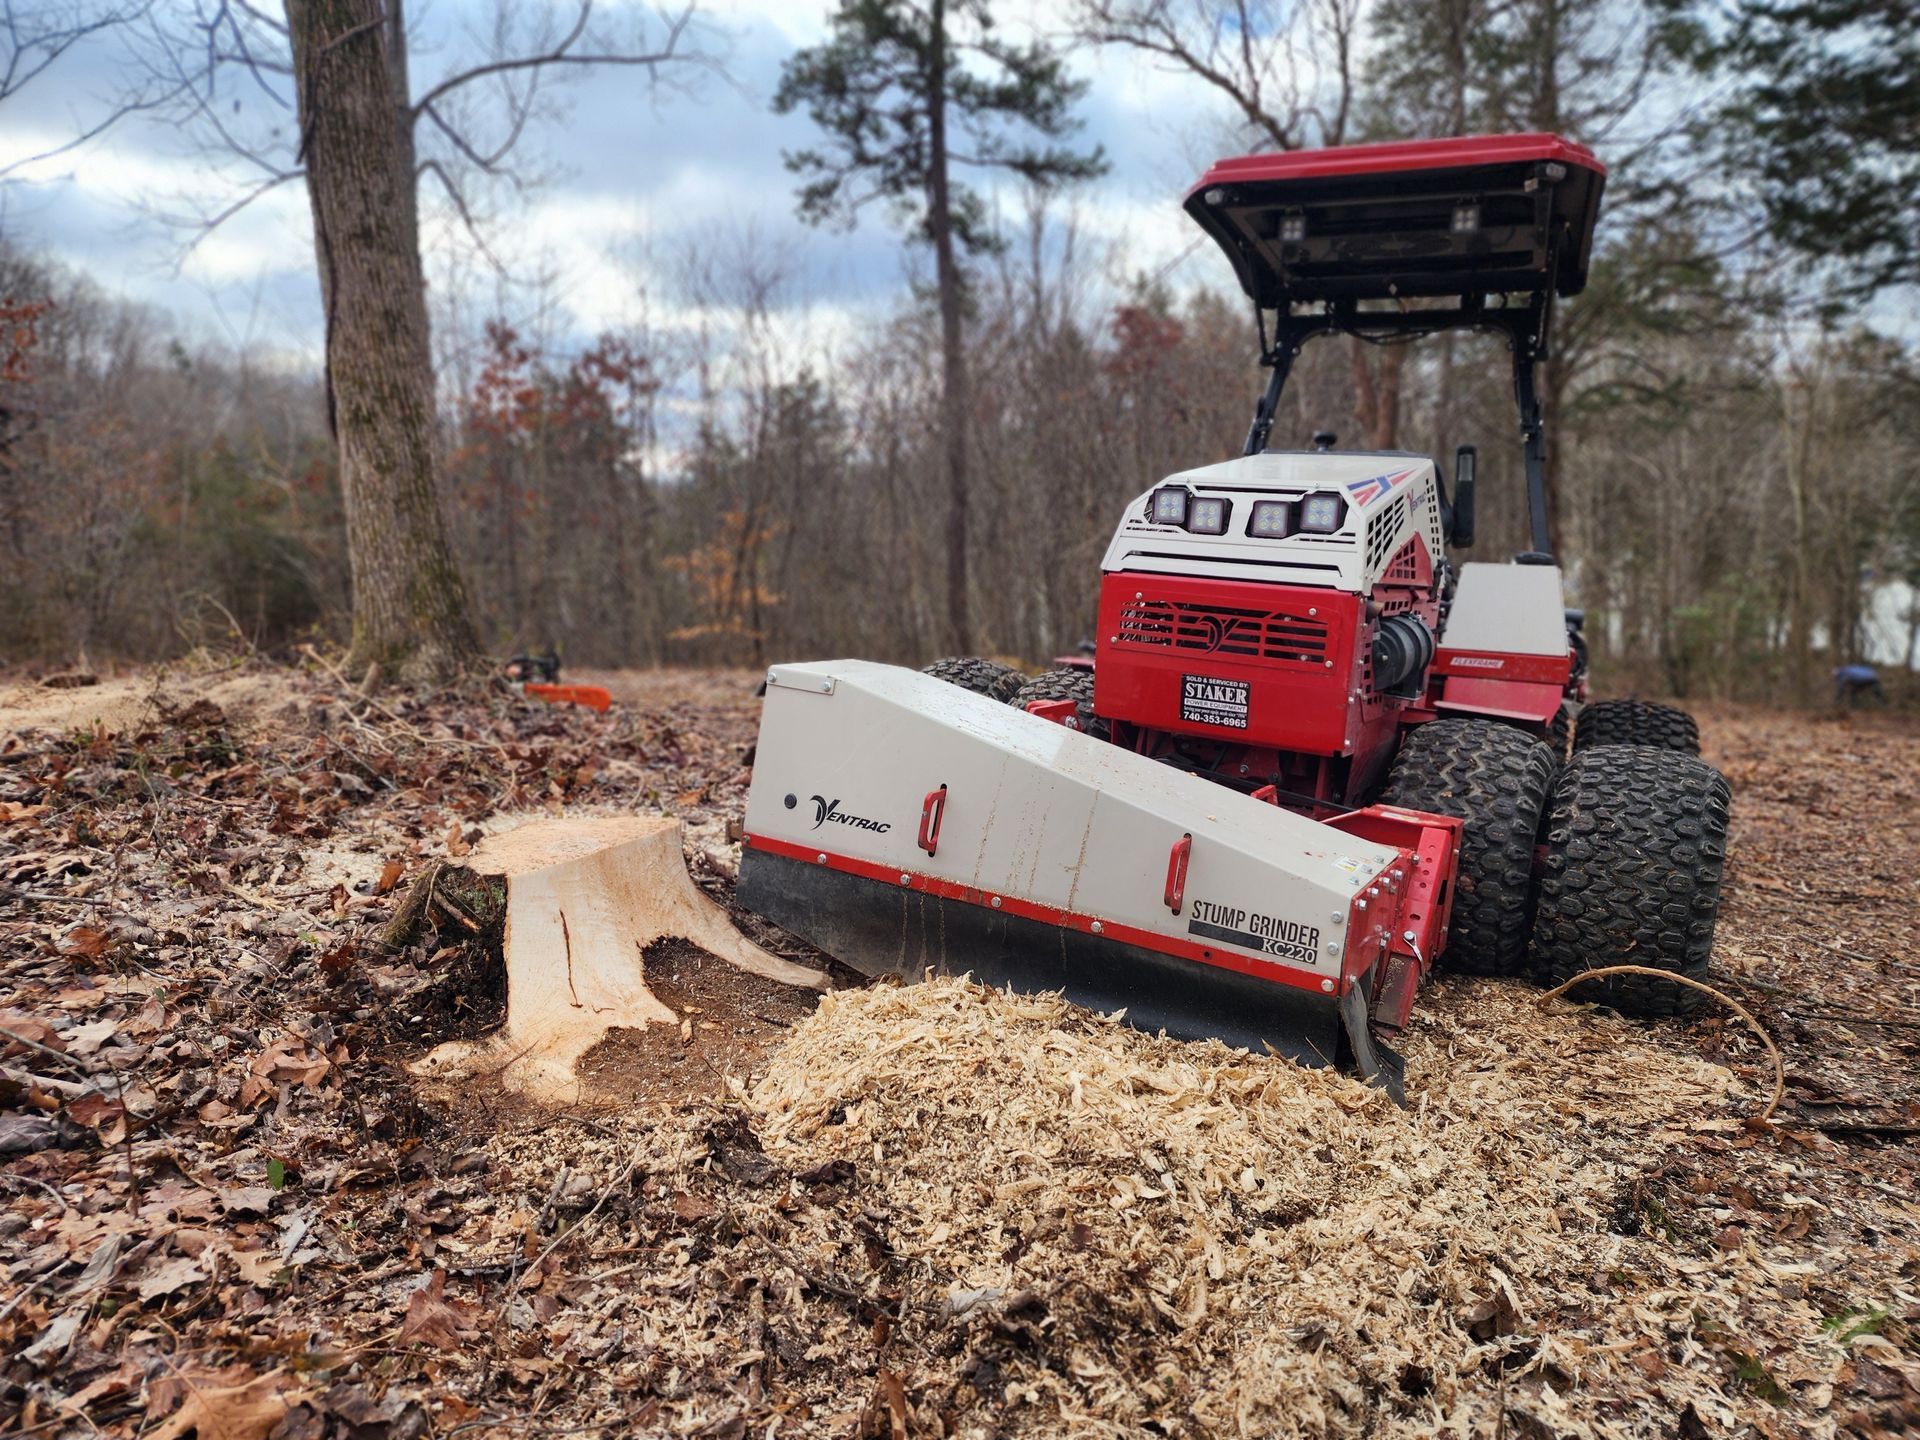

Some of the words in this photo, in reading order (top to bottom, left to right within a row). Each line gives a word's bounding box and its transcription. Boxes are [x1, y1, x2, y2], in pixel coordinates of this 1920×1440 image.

[1185, 682, 1247, 704] STAKER
[1208, 678, 1238, 687] SERVICED
[1185, 699, 1209, 707] POWER
[1209, 703, 1246, 712] EQUIPMENT
[1184, 711, 1247, 728] 740-353-6965
[809, 795, 891, 833] VENTRAC
[1192, 900, 1246, 929] STUMP
[1249, 913, 1320, 948] GRINDER
[1261, 939, 1316, 963] KC220
